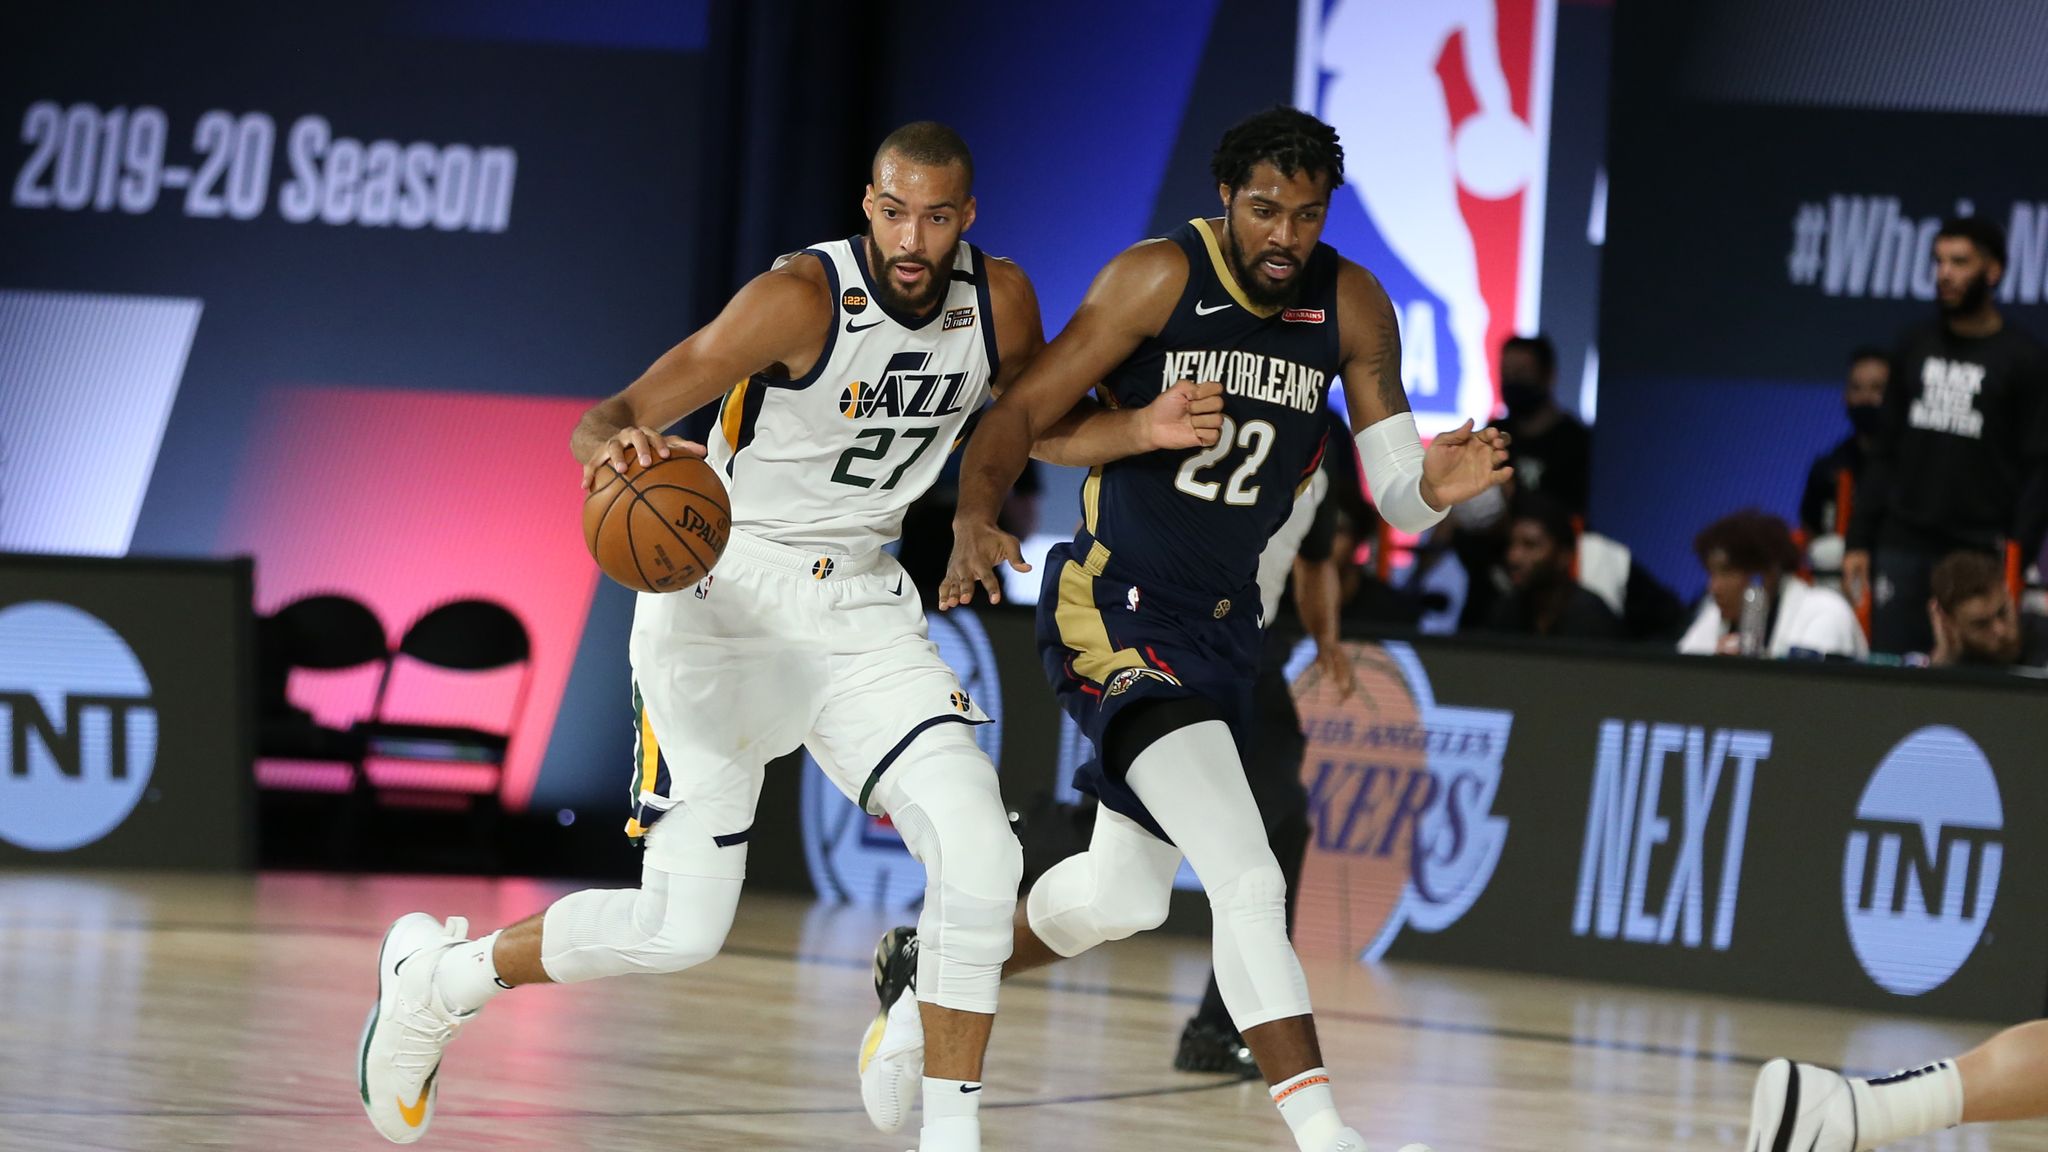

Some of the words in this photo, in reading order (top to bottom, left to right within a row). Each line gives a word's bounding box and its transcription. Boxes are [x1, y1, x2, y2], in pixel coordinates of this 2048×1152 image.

[14, 101, 275, 219] 2019-20
[279, 114, 518, 233] Season
[843, 295, 866, 305] 1223
[944, 312, 954, 329] 5
[952, 317, 973, 327] FIGHT
[839, 351, 969, 419] JAZZ
[1161, 350, 1229, 393] NEW
[1225, 350, 1325, 414] ORLEANS
[830, 426, 940, 490] 27
[1174, 412, 1277, 506] 22
[675, 504, 726, 561] SPALD
[1362, 725, 1492, 757] ANGELES
[1306, 760, 1486, 903] KERS
[1571, 718, 1773, 951] NEXT
